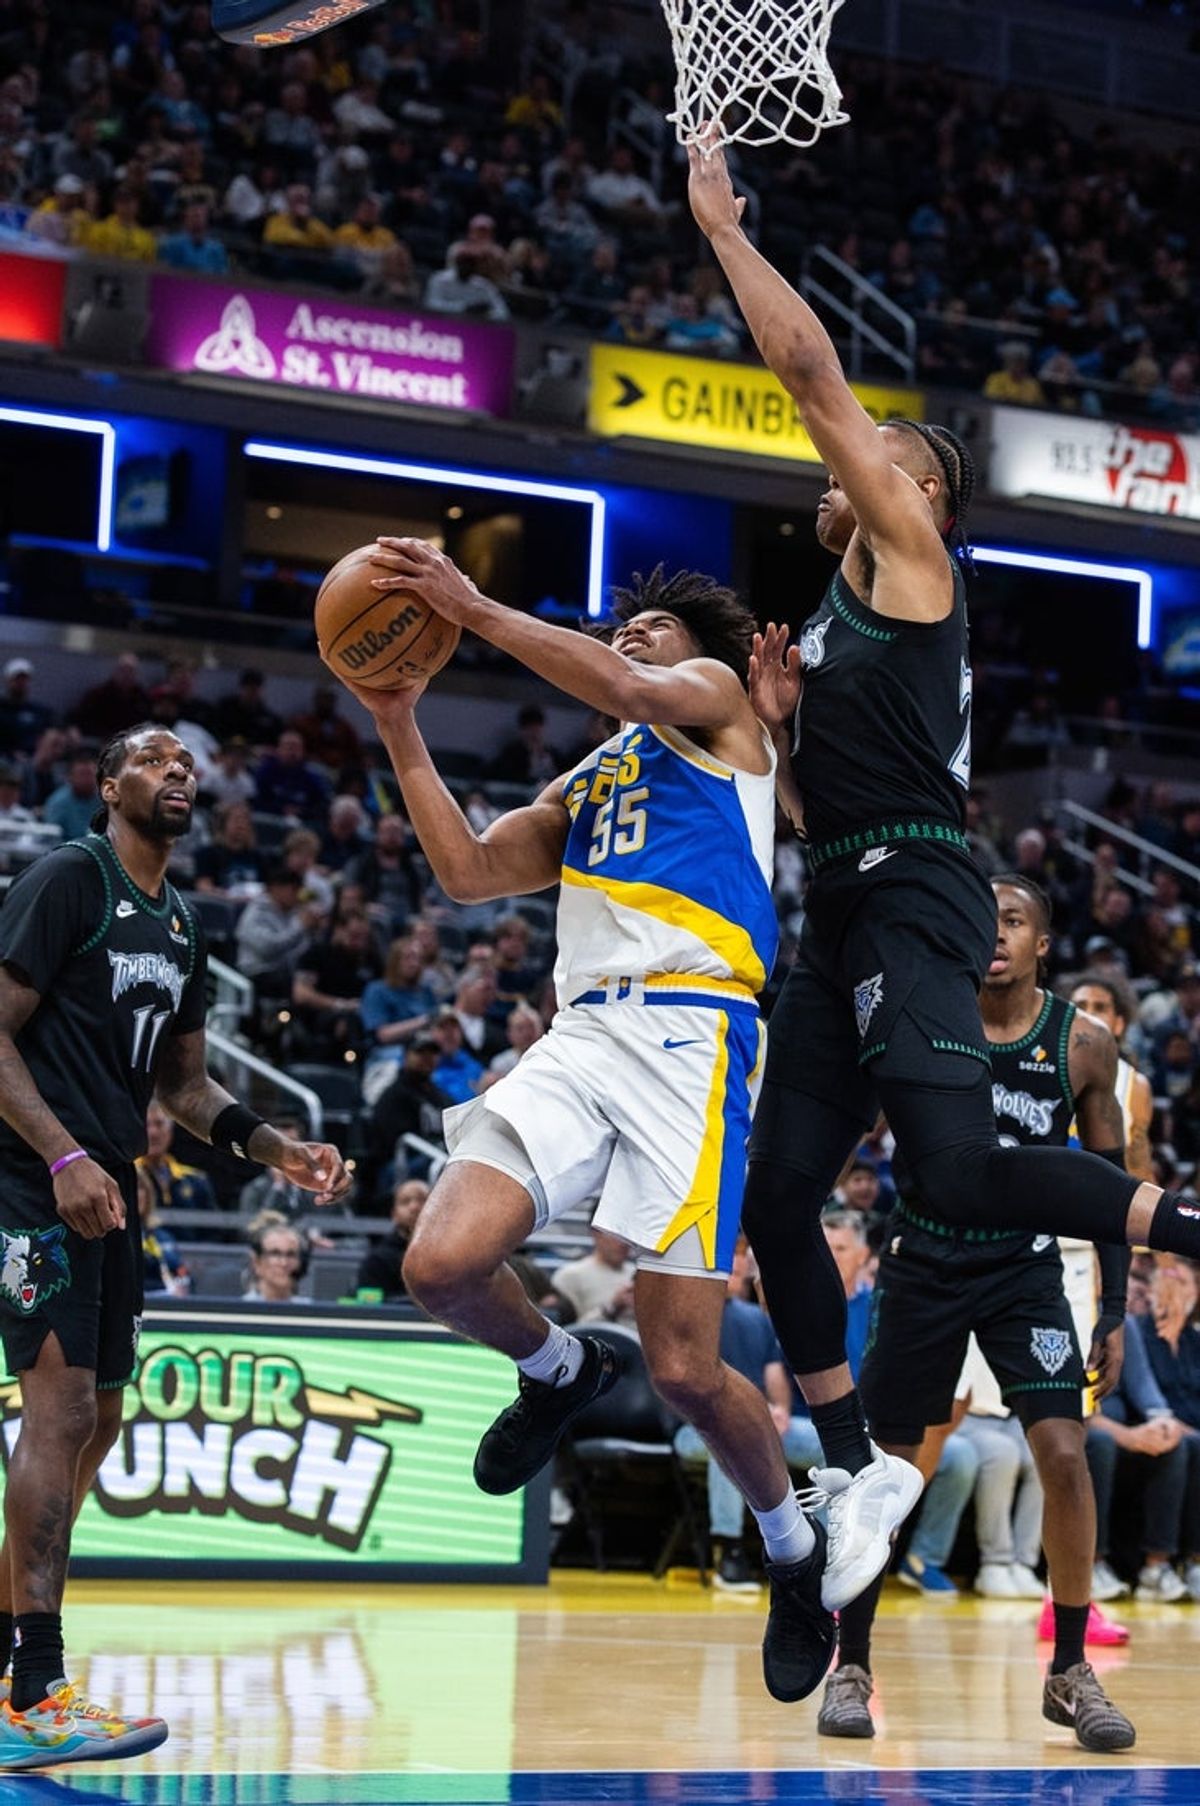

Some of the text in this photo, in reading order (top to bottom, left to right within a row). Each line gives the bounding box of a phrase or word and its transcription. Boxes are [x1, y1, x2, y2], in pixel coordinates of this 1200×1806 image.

[285, 303, 463, 363] Ascension
[282, 345, 467, 407] St. Vincent
[338, 605, 421, 670] Wilson
[588, 786, 650, 867] 55
[131, 1003, 171, 1073] 11
[1019, 1061, 1056, 1074] sezzle
[2, 1419, 391, 1536] UNCH
